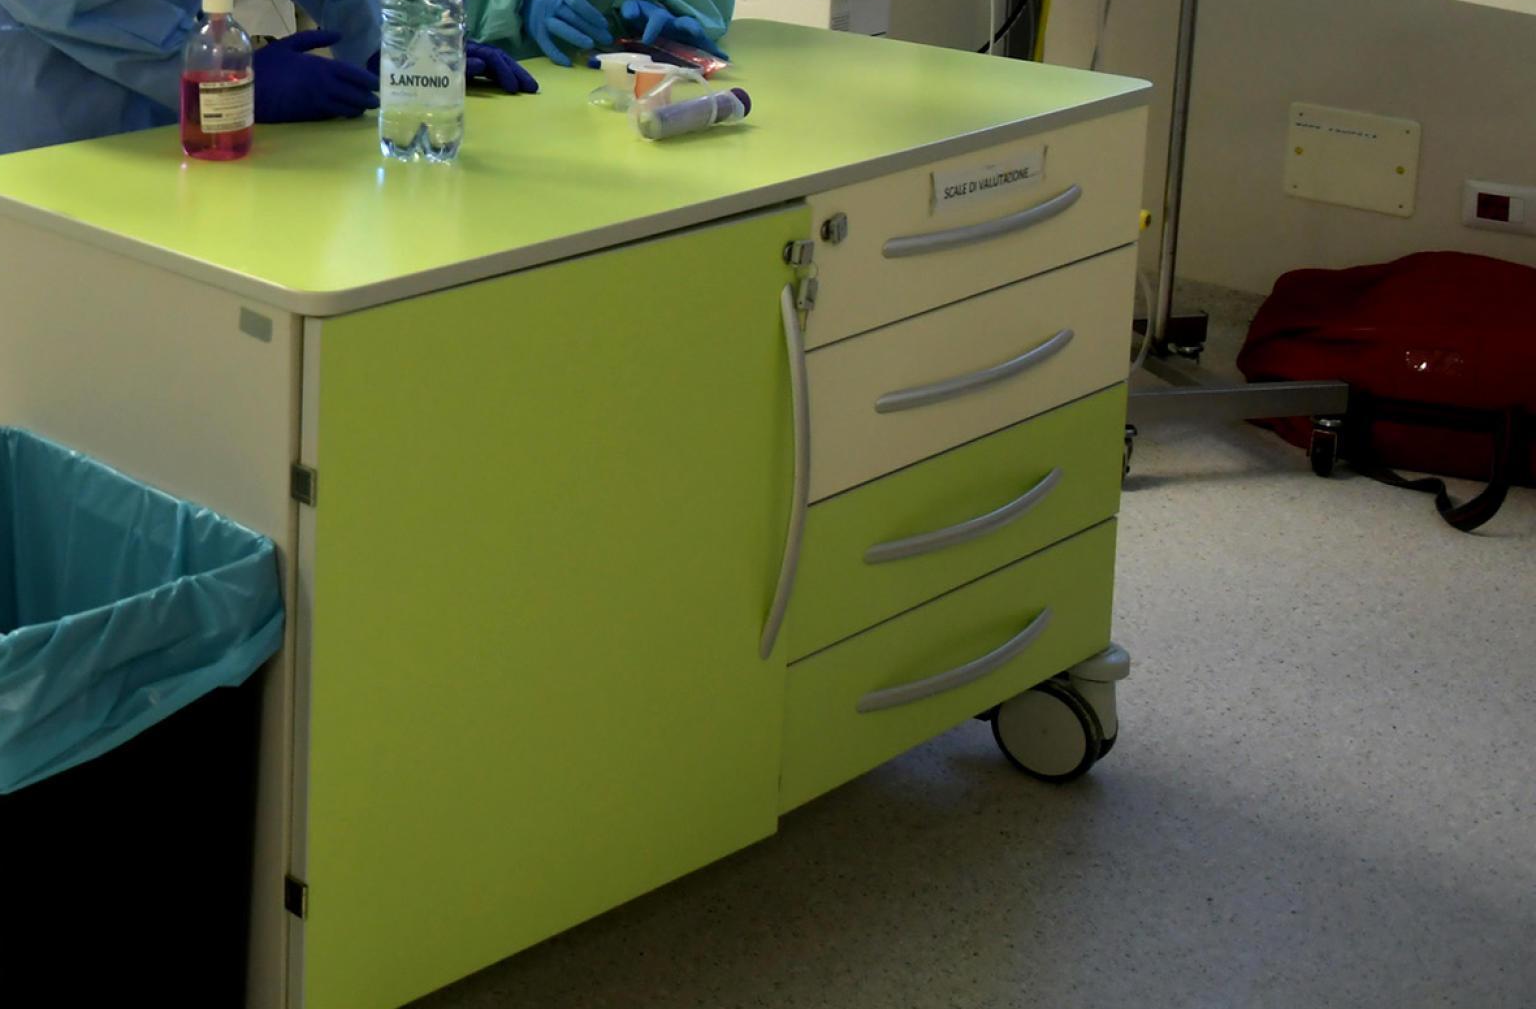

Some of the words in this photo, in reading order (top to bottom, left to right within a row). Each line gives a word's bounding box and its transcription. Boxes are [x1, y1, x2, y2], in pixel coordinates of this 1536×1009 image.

[390, 73, 450, 88] S.ANTONIO
[944, 182, 966, 199] SCALE
[969, 181, 978, 193] DI
[978, 167, 1029, 190] VALUTAZIONE
